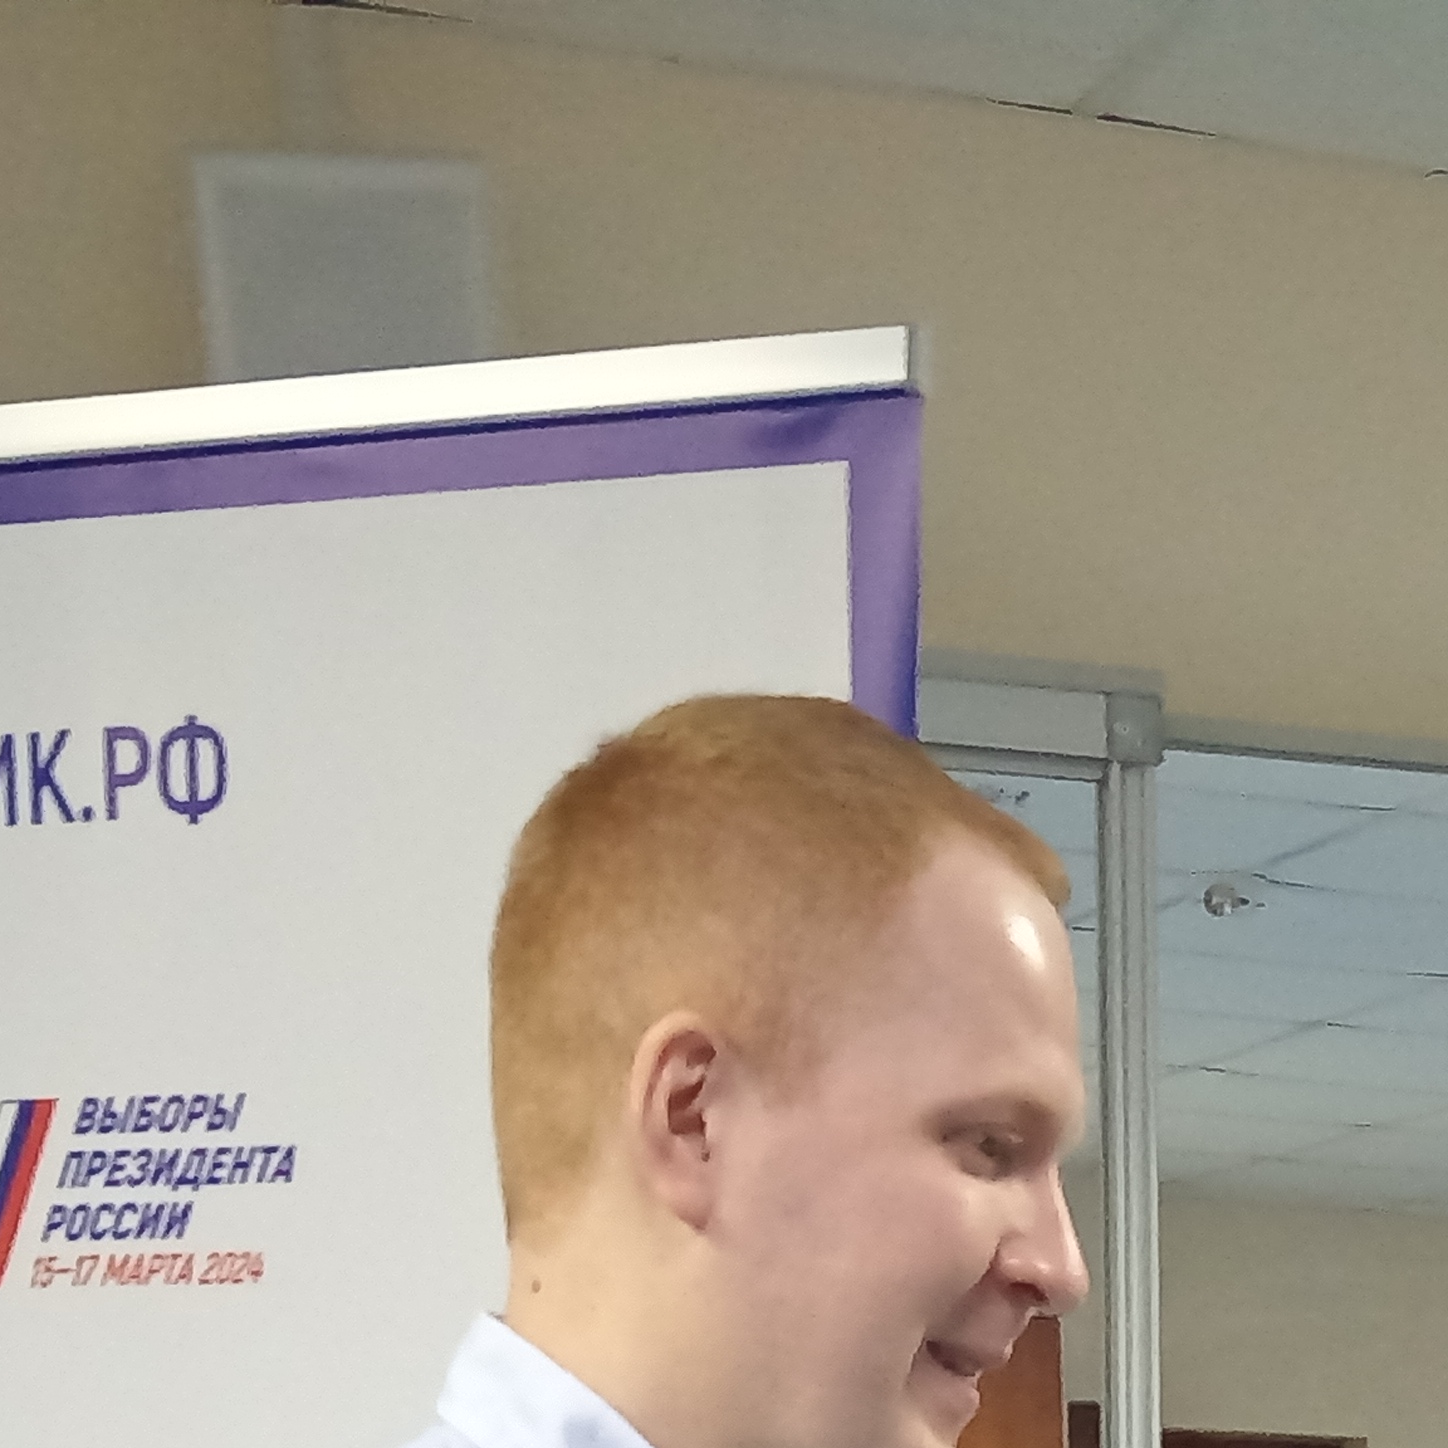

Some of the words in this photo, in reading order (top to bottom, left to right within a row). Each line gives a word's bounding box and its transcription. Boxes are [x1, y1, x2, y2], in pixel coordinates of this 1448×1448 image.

[72, 1092, 246, 1134] ВЫБОРЫ
[56, 1144, 297, 1191] ПРЕЗИДЕНТА
[40, 1200, 194, 1242] РОССИИ
[101, 1253, 195, 1286] МАРТА
[198, 1252, 265, 1286] 2024
